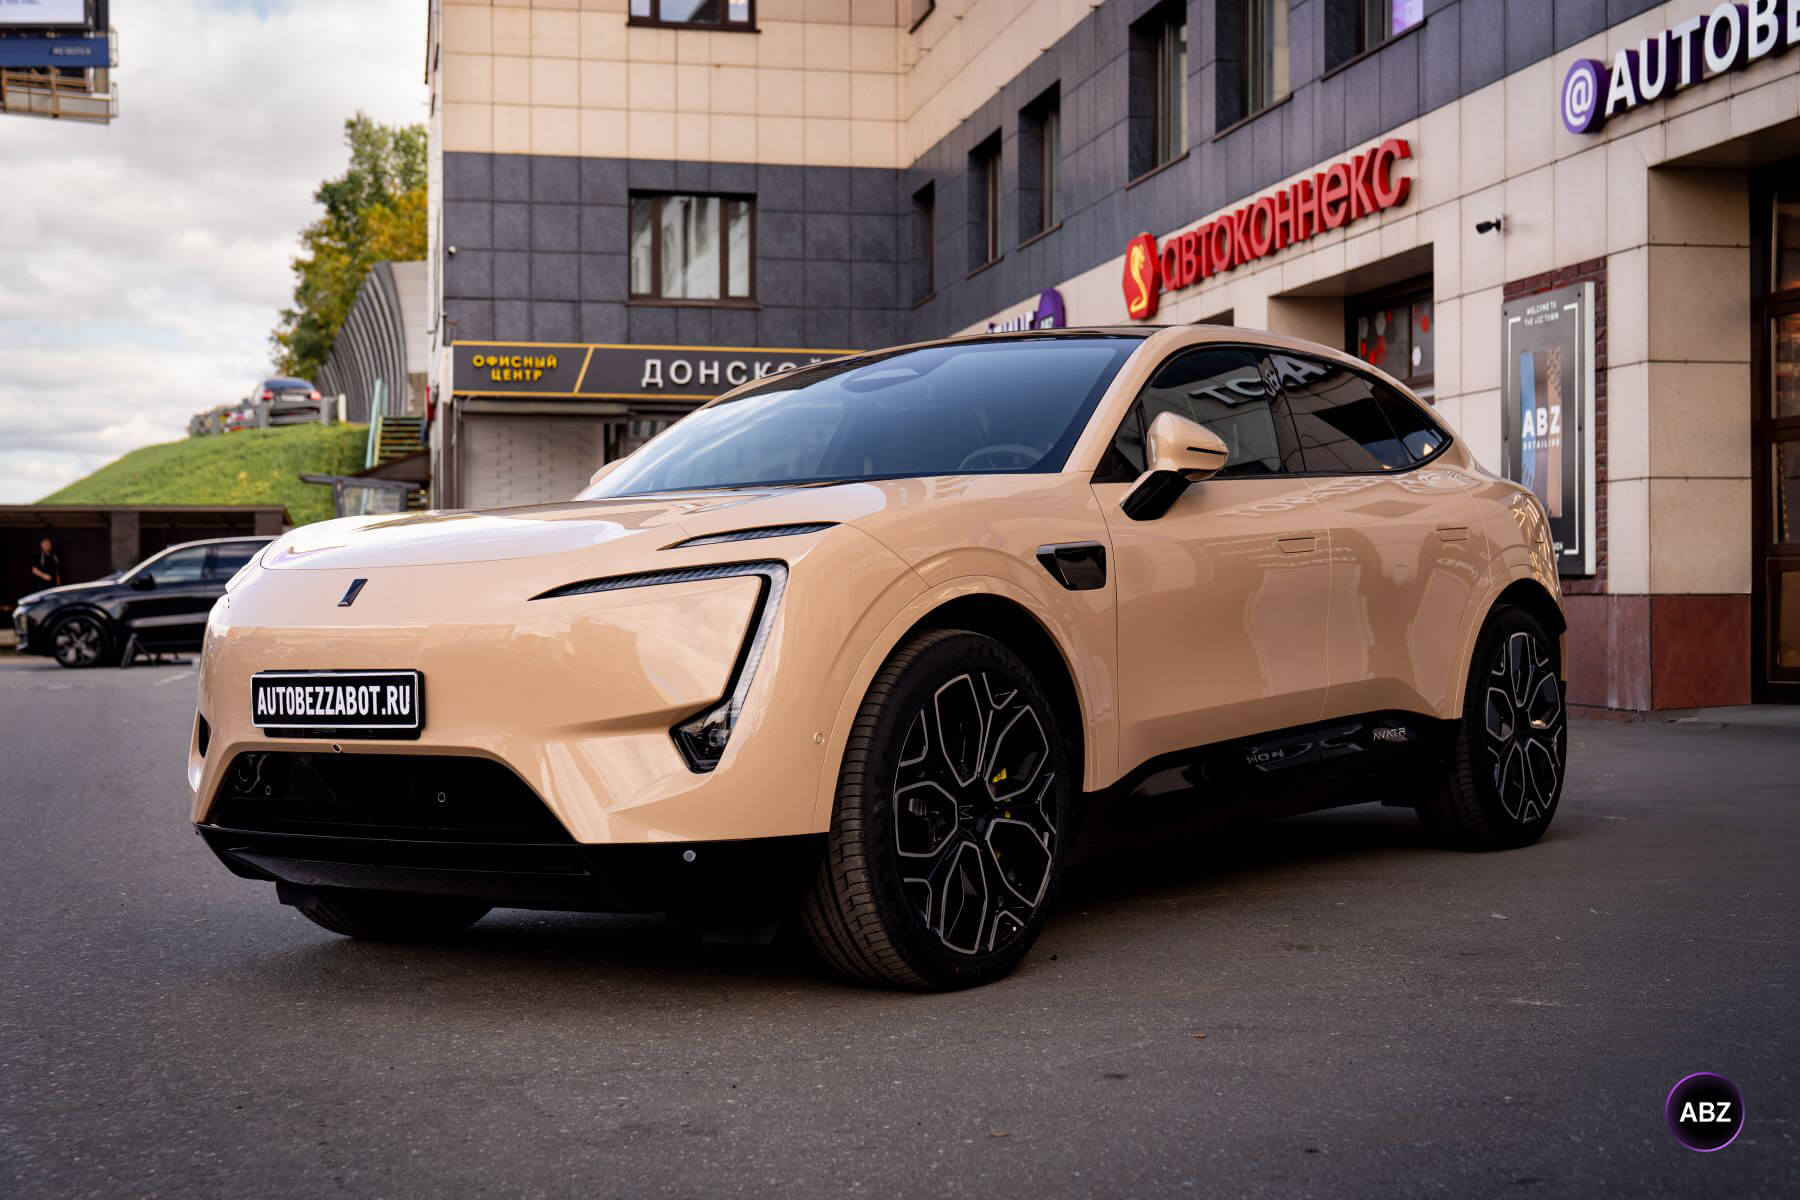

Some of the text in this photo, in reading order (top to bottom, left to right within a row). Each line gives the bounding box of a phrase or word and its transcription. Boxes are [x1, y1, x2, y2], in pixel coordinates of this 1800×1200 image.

[472, 354, 558, 369] ОФИСНЫЙ
[491, 368, 543, 382] ЦЕНТР
[641, 358, 822, 389] ДОНСК
[1522, 404, 1561, 439] ABZ
[257, 685, 411, 716] AUTOBEZZABOT.RU
